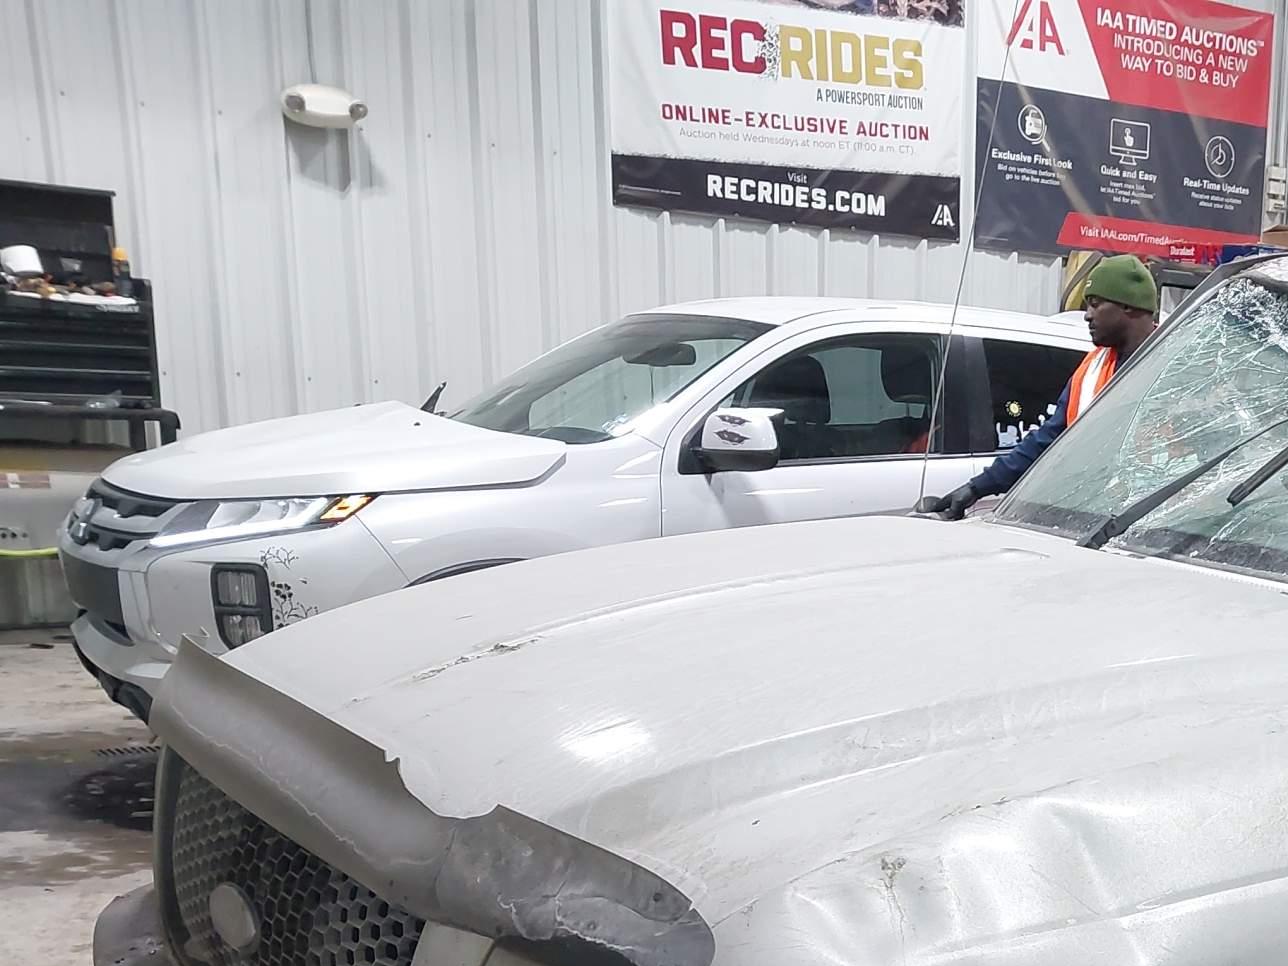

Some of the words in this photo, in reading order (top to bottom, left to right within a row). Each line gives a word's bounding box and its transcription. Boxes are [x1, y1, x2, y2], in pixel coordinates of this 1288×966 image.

[1096, 7, 1124, 30] IAA
[1126, 14, 1177, 40] TIMED
[1113, 33, 1203, 64] INTRODUCING
[1206, 53, 1216, 67] A
[1218, 55, 1248, 73] NEW
[1120, 53, 1153, 72] WAY
[1155, 59, 1174, 76] TO
[1176, 64, 1197, 81] BID
[1199, 68, 1210, 84] &
[1212, 71, 1239, 89] BUY
[816, 88, 825, 103] A
[826, 89, 885, 108] POWERSPORT
[887, 94, 924, 111] AUCTION
[661, 103, 849, 136] ONLINE-EXCLUSIVE
[856, 121, 930, 142] AUCTION
[680, 128, 716, 140] Auction
[718, 131, 740, 143] held
[742, 133, 800, 149] Wednesdays
[801, 140, 810, 148] at
[813, 141, 836, 150] noon
[839, 142, 851, 151] ET
[991, 147, 1032, 164] Exclusive
[1033, 154, 1052, 166] First
[786, 172, 809, 185] Visit
[1100, 164, 1121, 178] Quick
[1122, 169, 1137, 179] and
[1138, 170, 1158, 184] Easy
[706, 174, 887, 218] RECRIDES.COM
[1183, 177, 1221, 191] Real-Time
[1222, 183, 1250, 196] Updates
[1079, 225, 1100, 238] Visit
